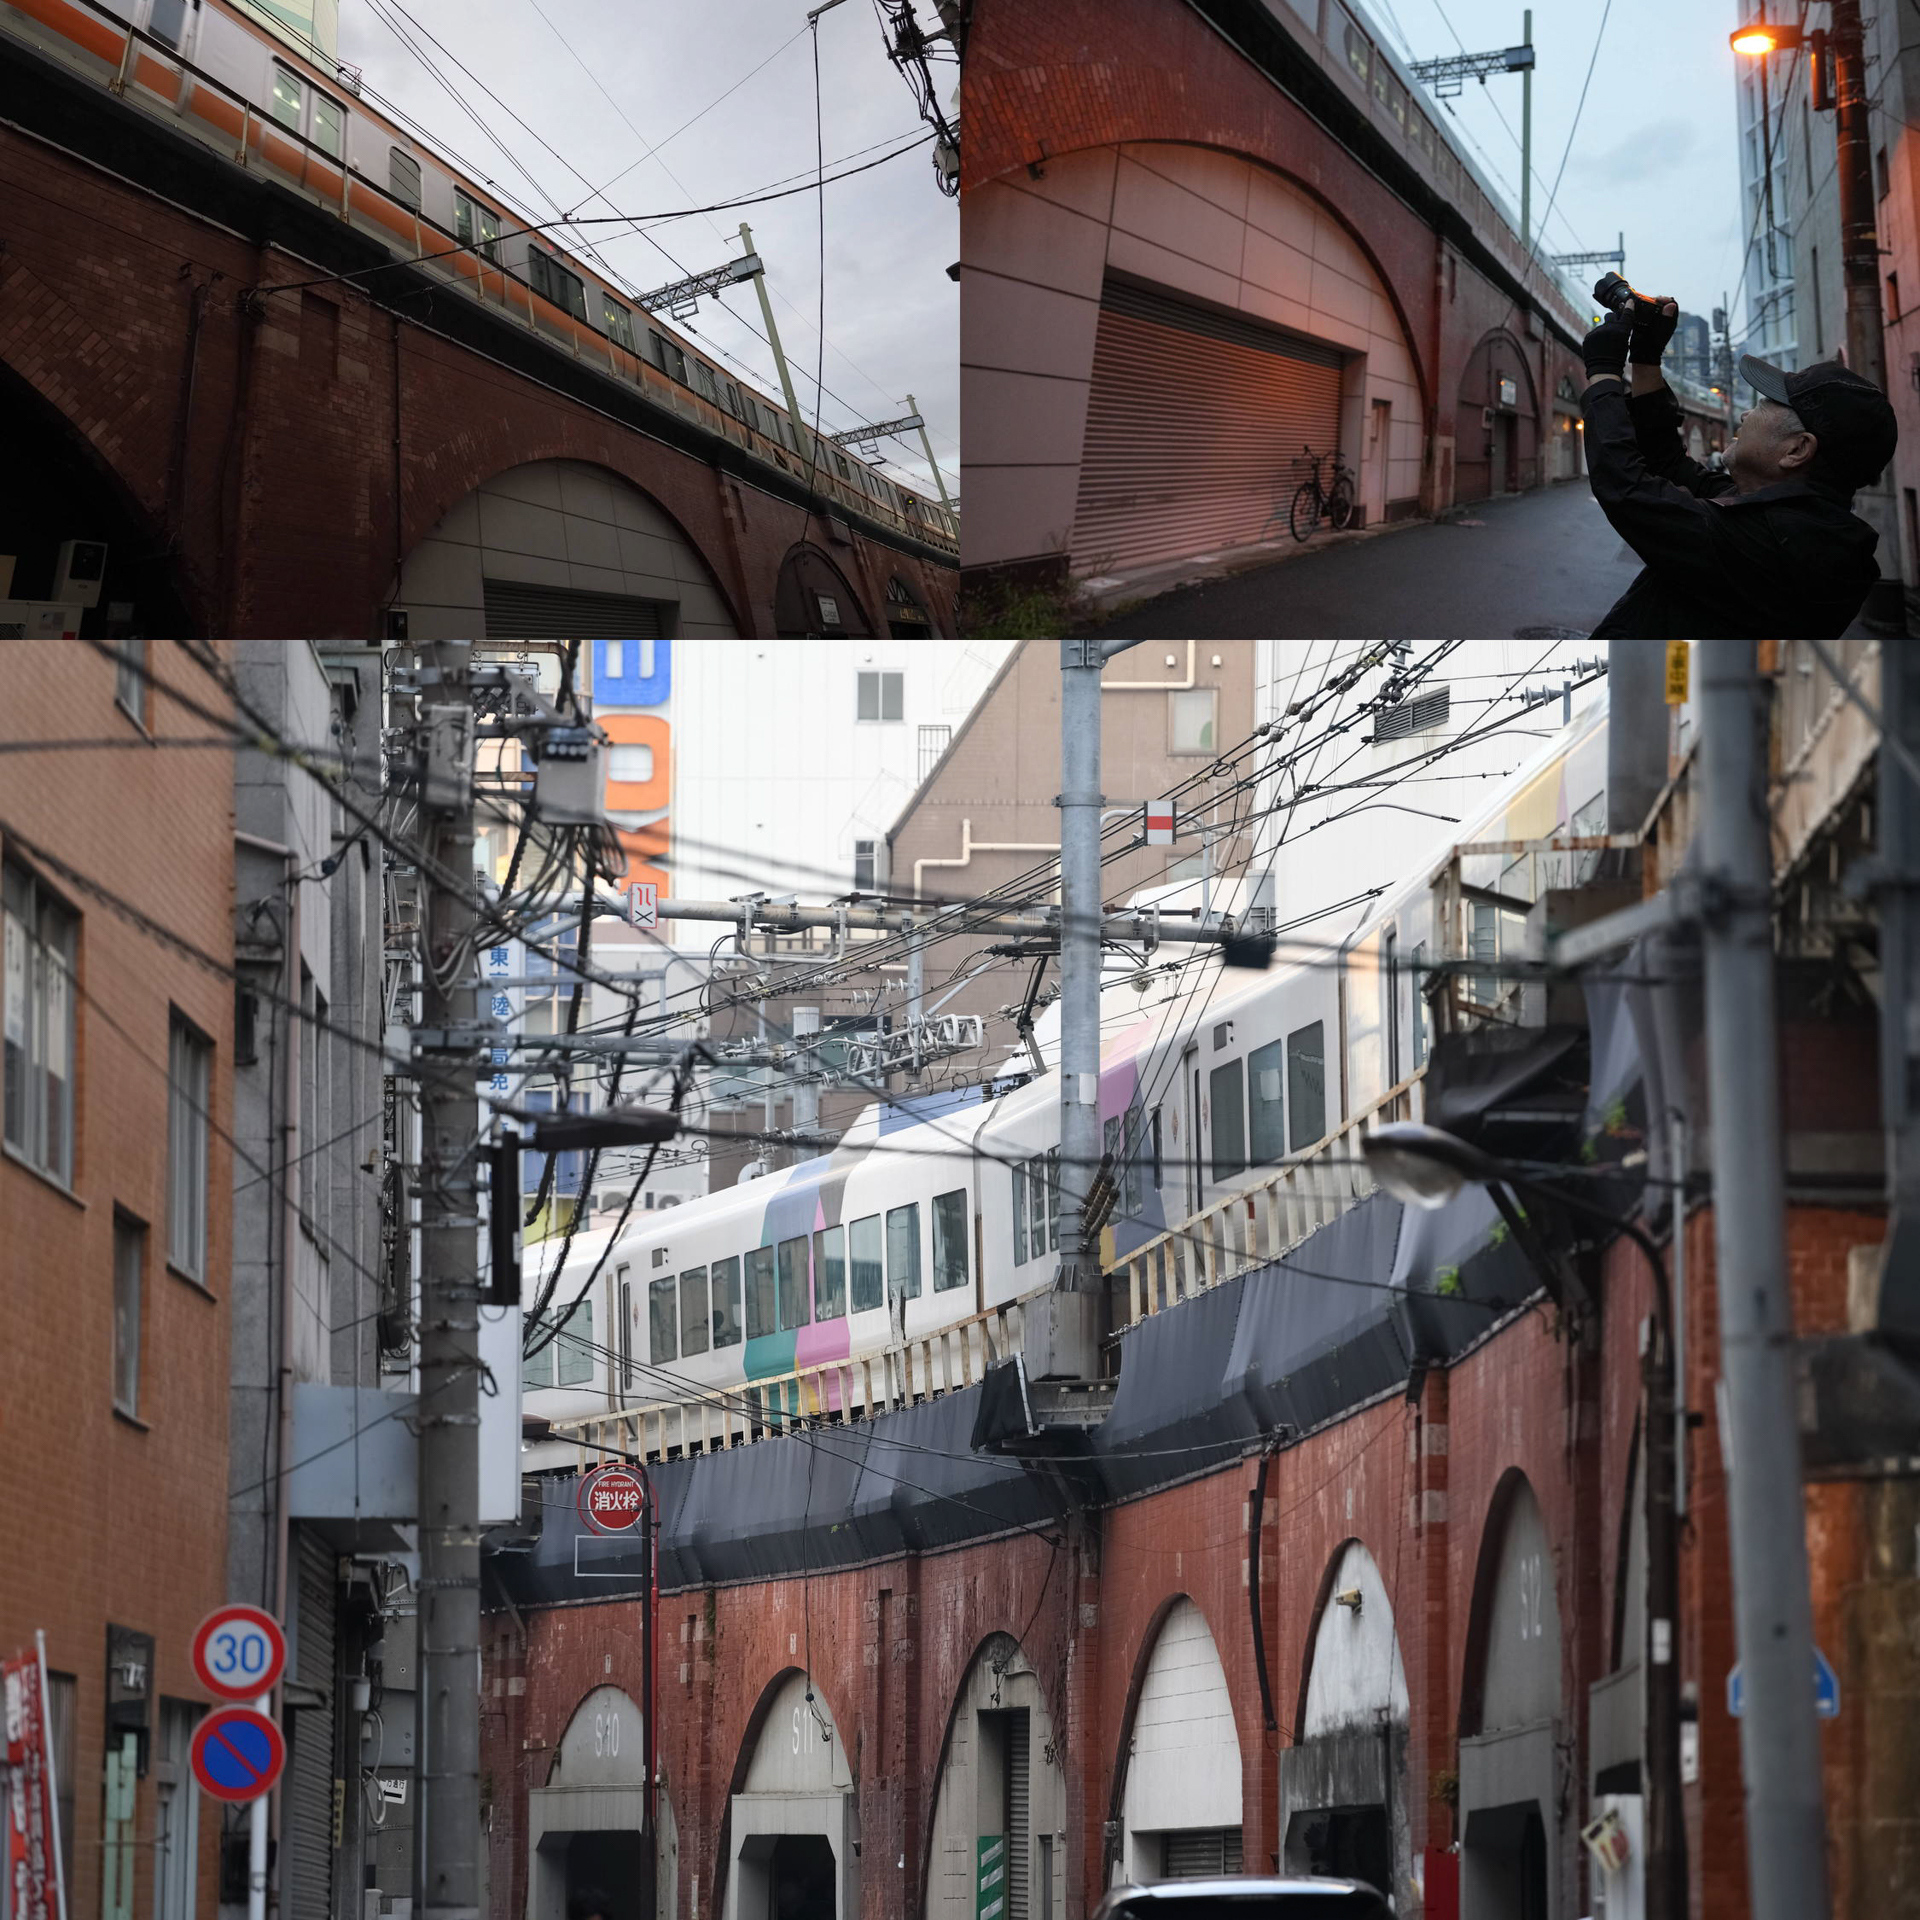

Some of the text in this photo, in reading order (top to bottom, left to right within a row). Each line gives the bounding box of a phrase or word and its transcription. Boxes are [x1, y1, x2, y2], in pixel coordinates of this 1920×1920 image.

[594, 1491, 639, 1511] 消火栓
[1520, 1553, 1541, 1640] S12
[214, 1633, 264, 1673] 30
[595, 1713, 619, 1757] S10
[792, 1706, 813, 1755] S11
